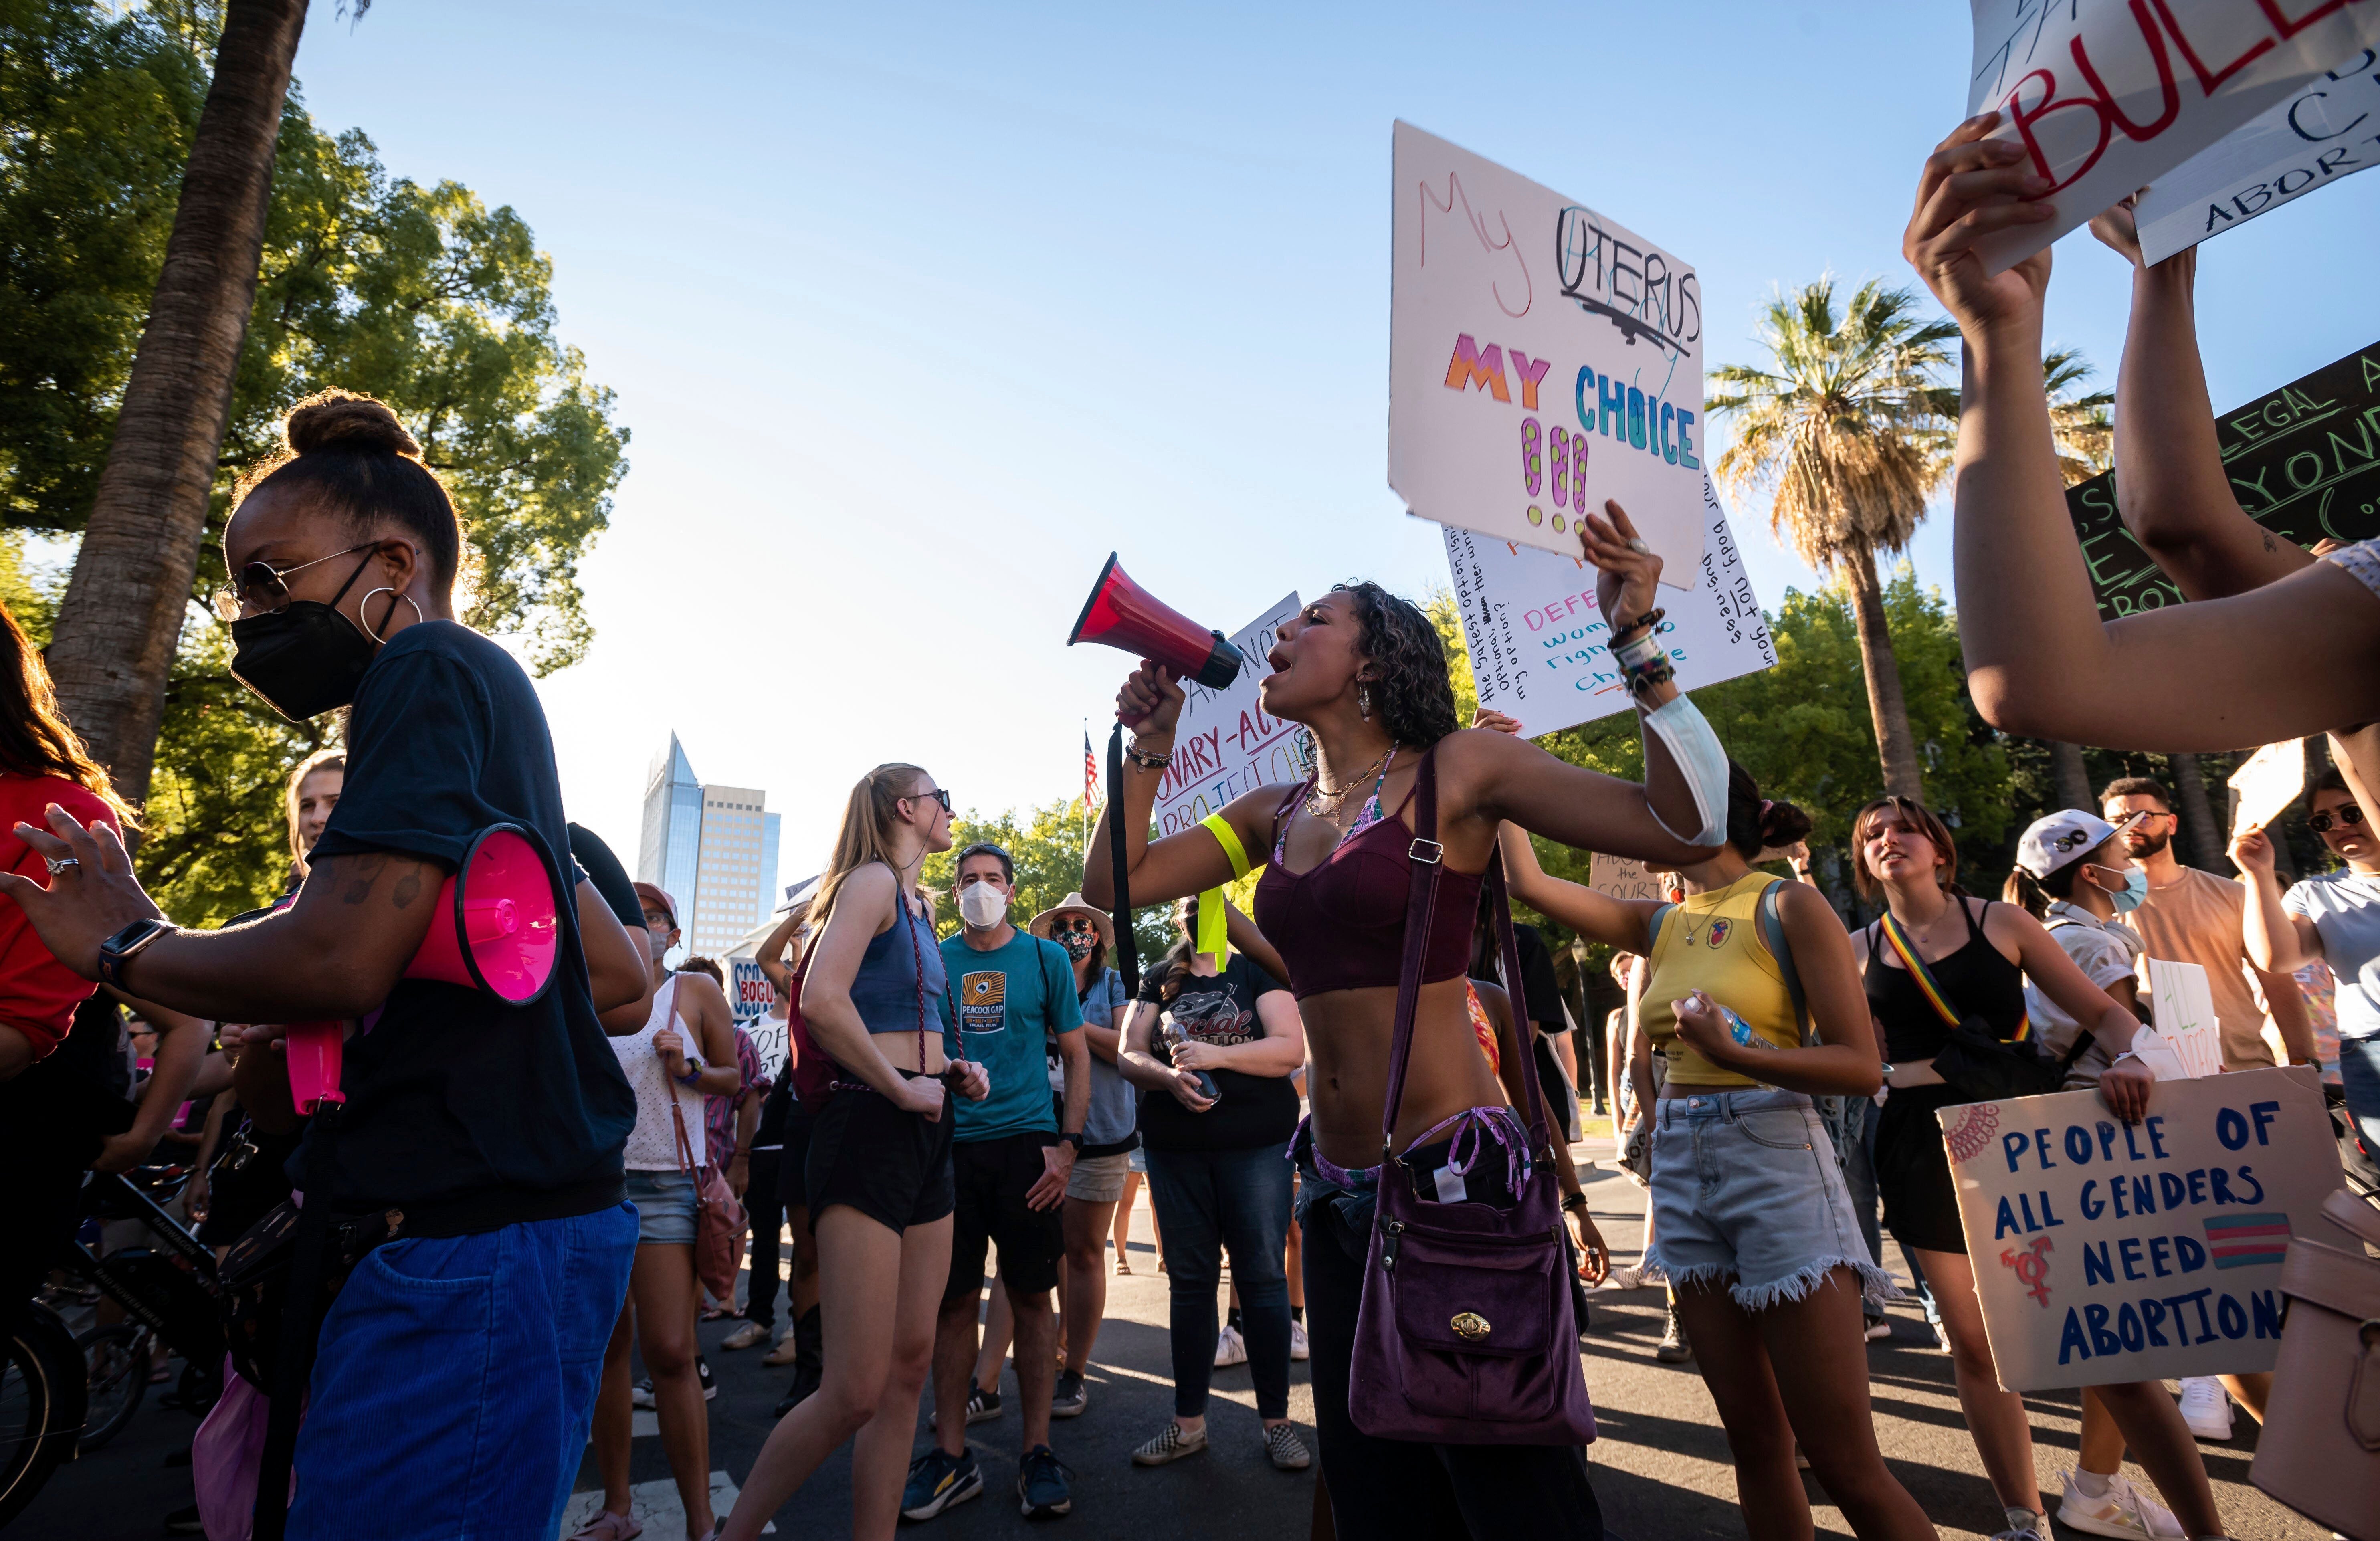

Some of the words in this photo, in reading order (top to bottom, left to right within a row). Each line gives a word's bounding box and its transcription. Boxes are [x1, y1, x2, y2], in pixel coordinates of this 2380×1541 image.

[2206, 135, 2380, 233] ABOR
[1421, 171, 1531, 318] My
[1556, 207, 1700, 342] UTERUS
[1445, 332, 1550, 411] MY
[1576, 364, 1700, 470] CHOICE
[1475, 561, 1485, 592] then
[1704, 468, 1719, 510] our
[1734, 576, 1758, 618] not
[1750, 626, 1776, 666] your
[1523, 588, 1599, 631] DEFE
[1702, 553, 1742, 644] business
[1543, 620, 1608, 648] wom
[1481, 673, 1495, 703] the
[1514, 671, 1528, 700] my
[1617, 867, 1638, 880] the
[741, 980, 776, 1003] BOGU
[962, 1005, 990, 1014] PEACOCK
[990, 1005, 1004, 1013] GAP
[2002, 1115, 2170, 1173] PEOPLE
[2216, 1100, 2281, 1151] OF
[1994, 1190, 2065, 1240] ALL
[2080, 1165, 2265, 1221] GENDERS
[152, 1216, 198, 1256] RADWAGON
[2084, 1234, 2206, 1286] NEED
[2058, 1287, 2282, 1365] ABORTION
